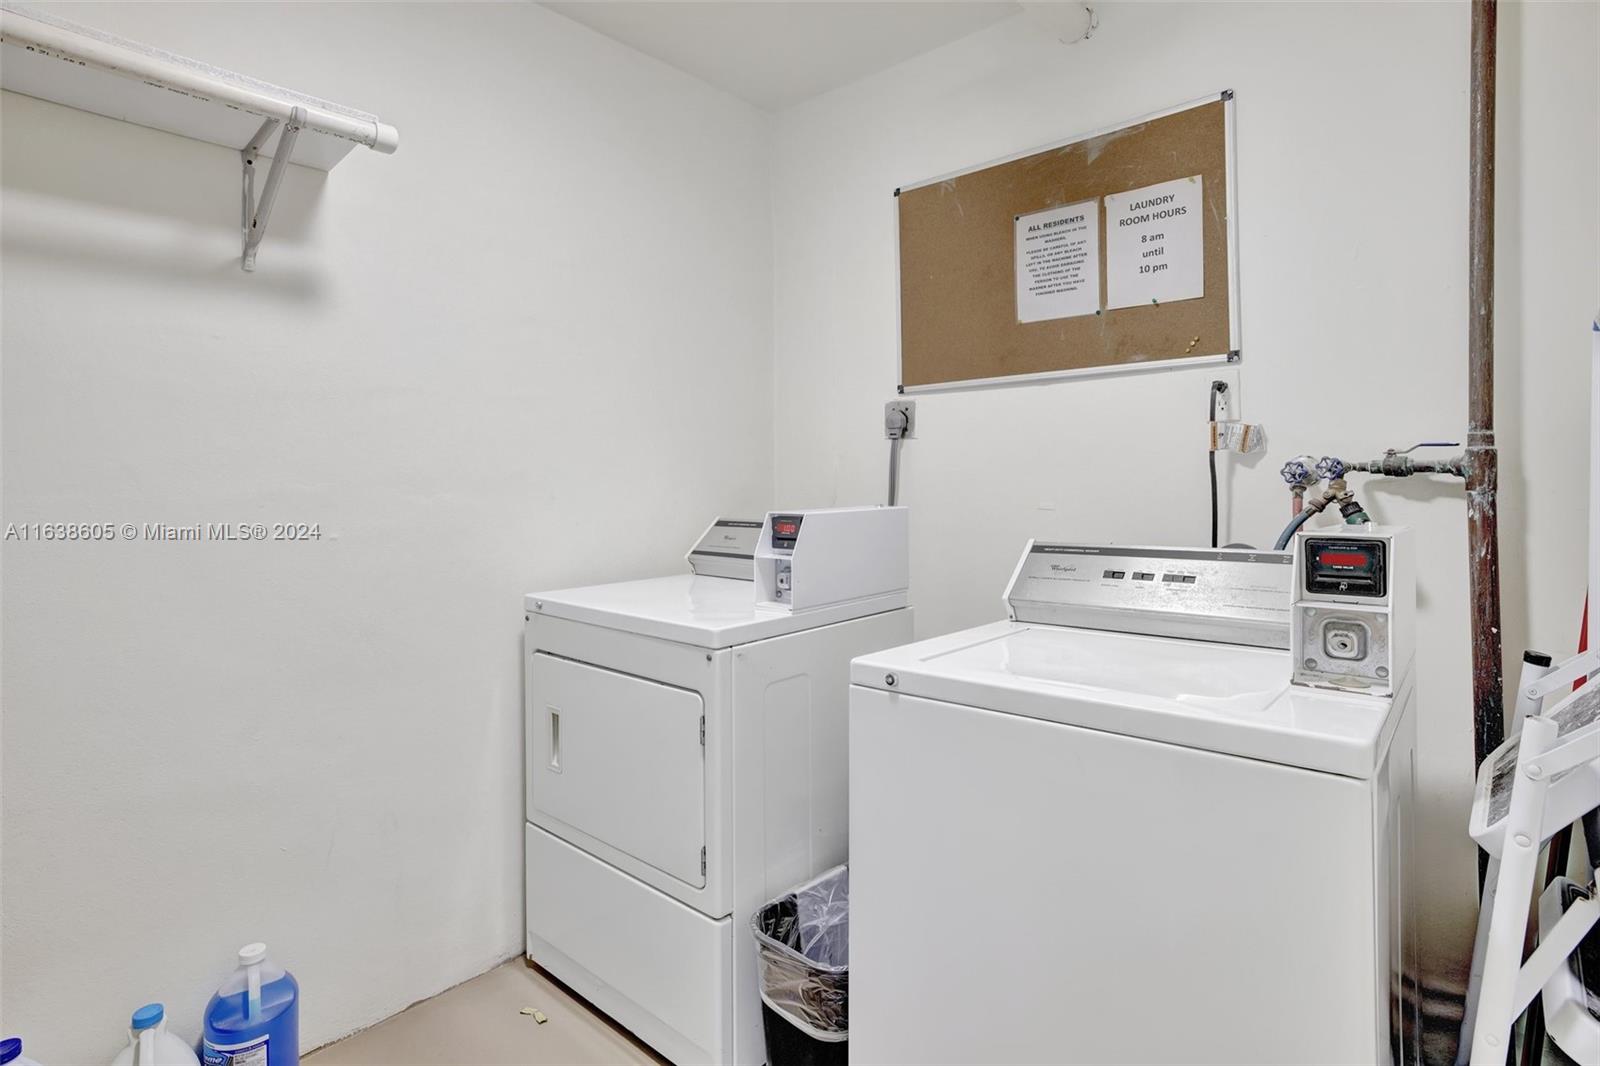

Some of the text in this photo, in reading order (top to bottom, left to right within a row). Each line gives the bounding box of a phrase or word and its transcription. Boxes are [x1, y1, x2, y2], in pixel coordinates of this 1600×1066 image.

[1130, 194, 1175, 212] LAUNDRY
[1028, 214, 1084, 232] ALL RESIDENTS
[1120, 206, 1187, 227] ROOM HOURS
[1141, 233, 1164, 243] 8 am
[1142, 246, 1164, 258] until
[1139, 263, 1168, 273] 10 pm
